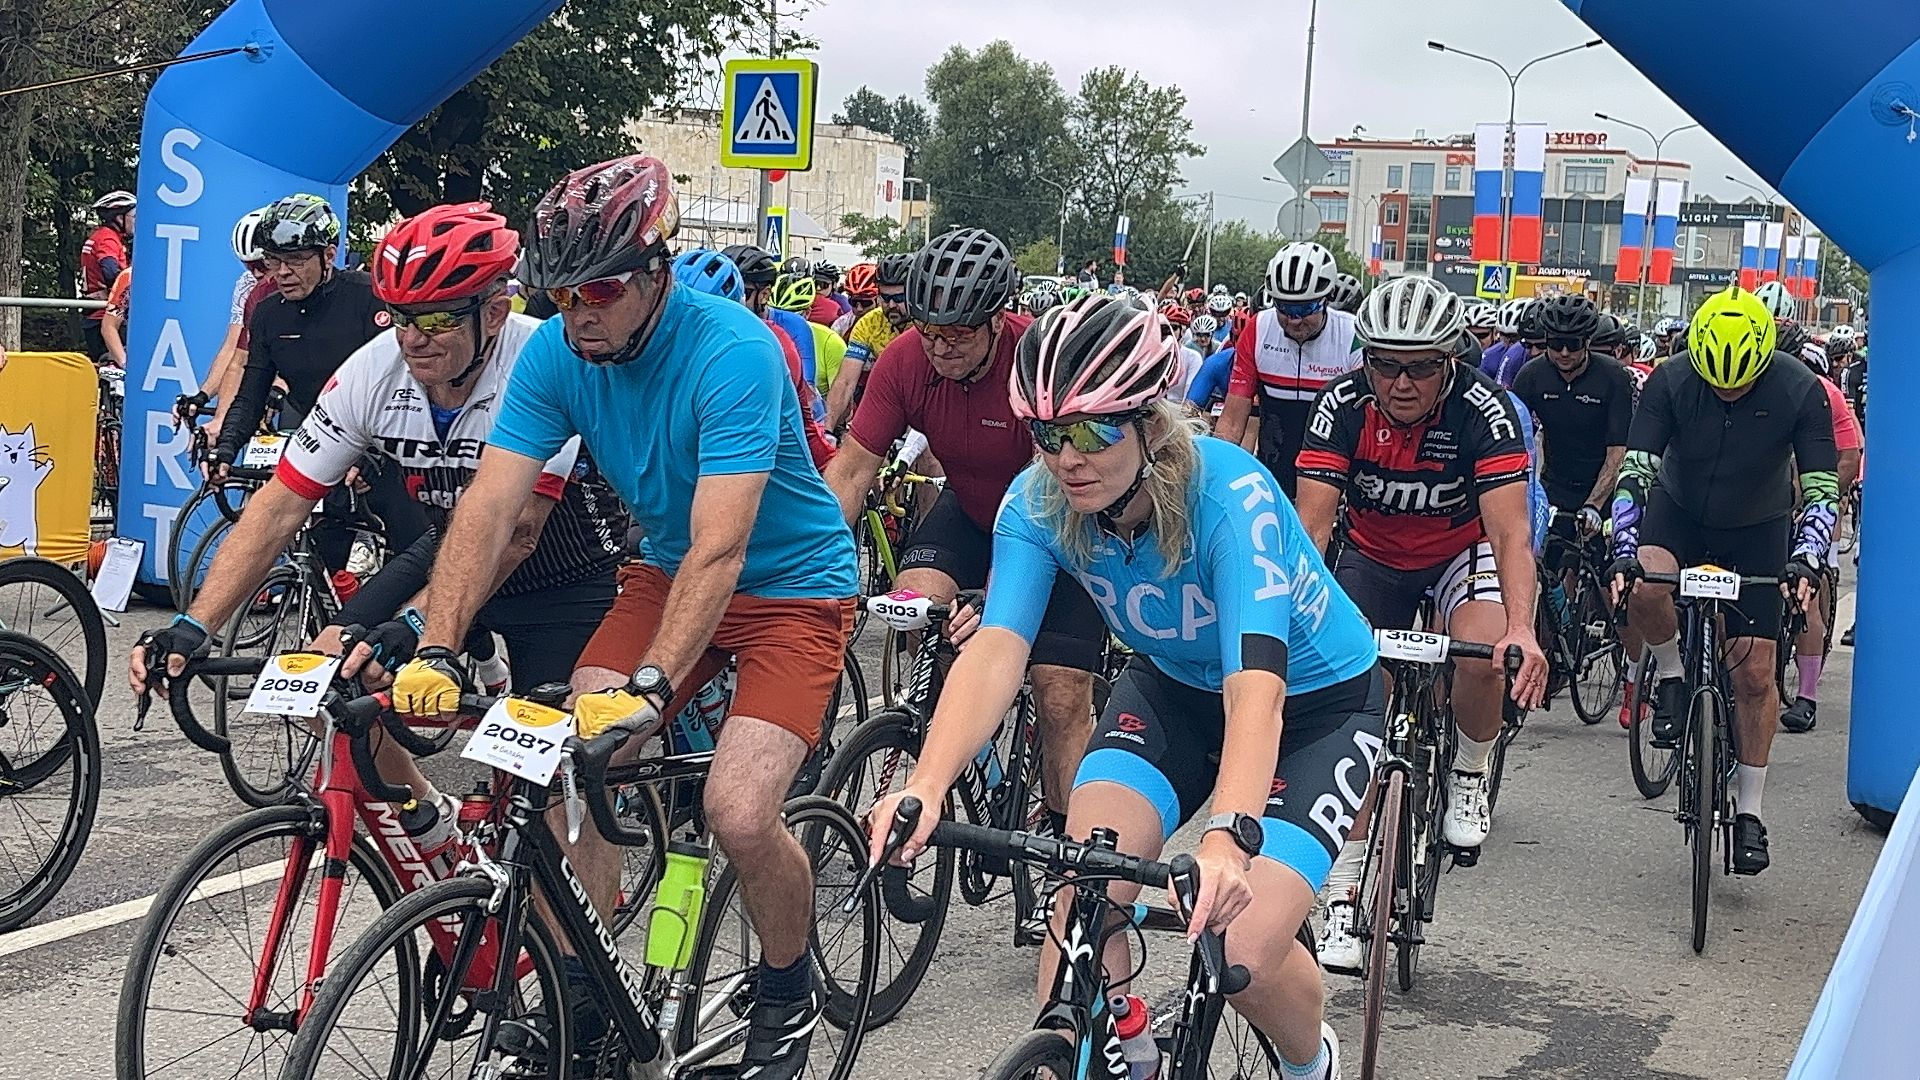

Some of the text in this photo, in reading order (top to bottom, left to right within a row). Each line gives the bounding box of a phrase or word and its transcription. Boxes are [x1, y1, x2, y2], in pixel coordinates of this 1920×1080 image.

[1554, 132, 1607, 145] ХУТОР
[1446, 153, 1476, 165] DN
[1681, 214, 1719, 223] LIGHT
[1537, 267, 1591, 277] ДОДО ПИЦЦА
[142, 127, 204, 580] START
[1310, 379, 1357, 441] BMC
[1463, 381, 1516, 441] BMC
[1426, 430, 1453, 441] BMC
[1354, 470, 1467, 511] BMC
[1229, 471, 1290, 602] RCA
[1686, 573, 1734, 584] 2046
[875, 603, 918, 617] 3103
[1079, 570, 1217, 641] RCA
[1386, 630, 1438, 645] 3105
[260, 678, 319, 694] 2098
[483, 723, 556, 755] 2087
[1308, 730, 1384, 852] RCA
[561, 854, 656, 1031] cannondale
